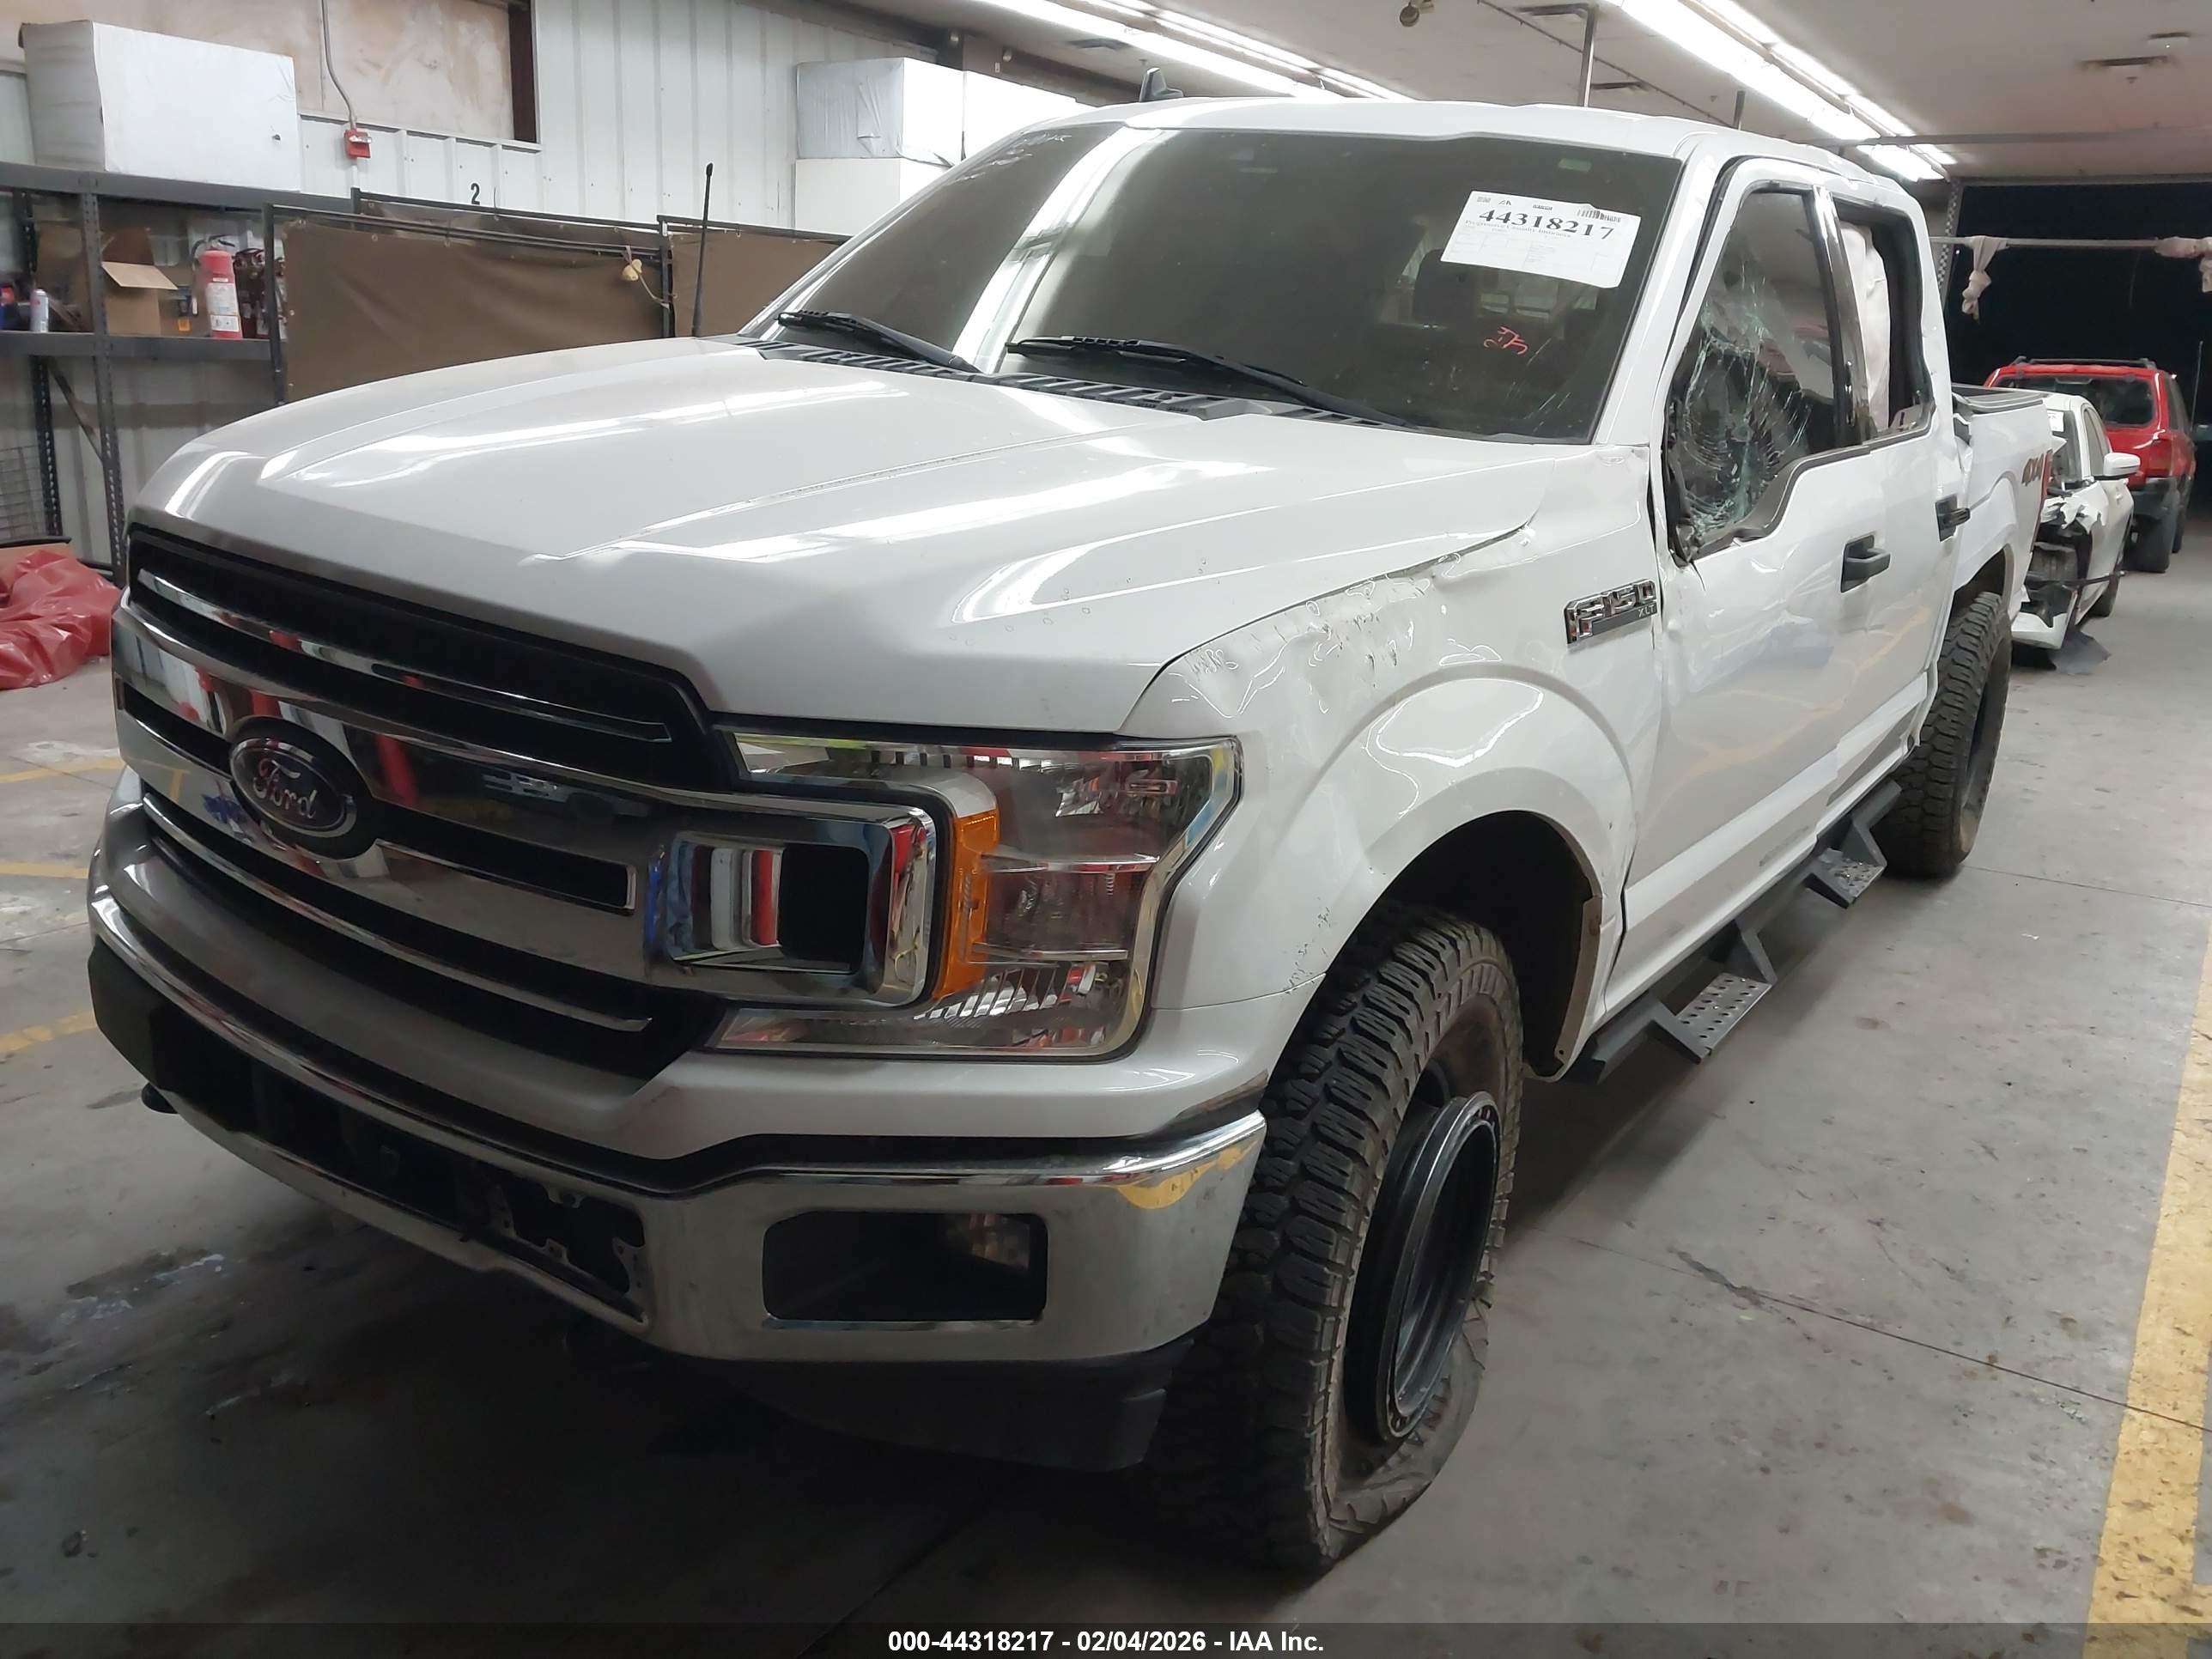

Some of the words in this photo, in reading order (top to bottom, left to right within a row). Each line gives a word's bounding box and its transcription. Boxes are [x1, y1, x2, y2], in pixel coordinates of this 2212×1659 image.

[471, 183, 480, 205] 2
[1479, 210, 1614, 240] 44318217
[1638, 604, 1656, 618] XLT
[252, 757, 319, 819] Ford
